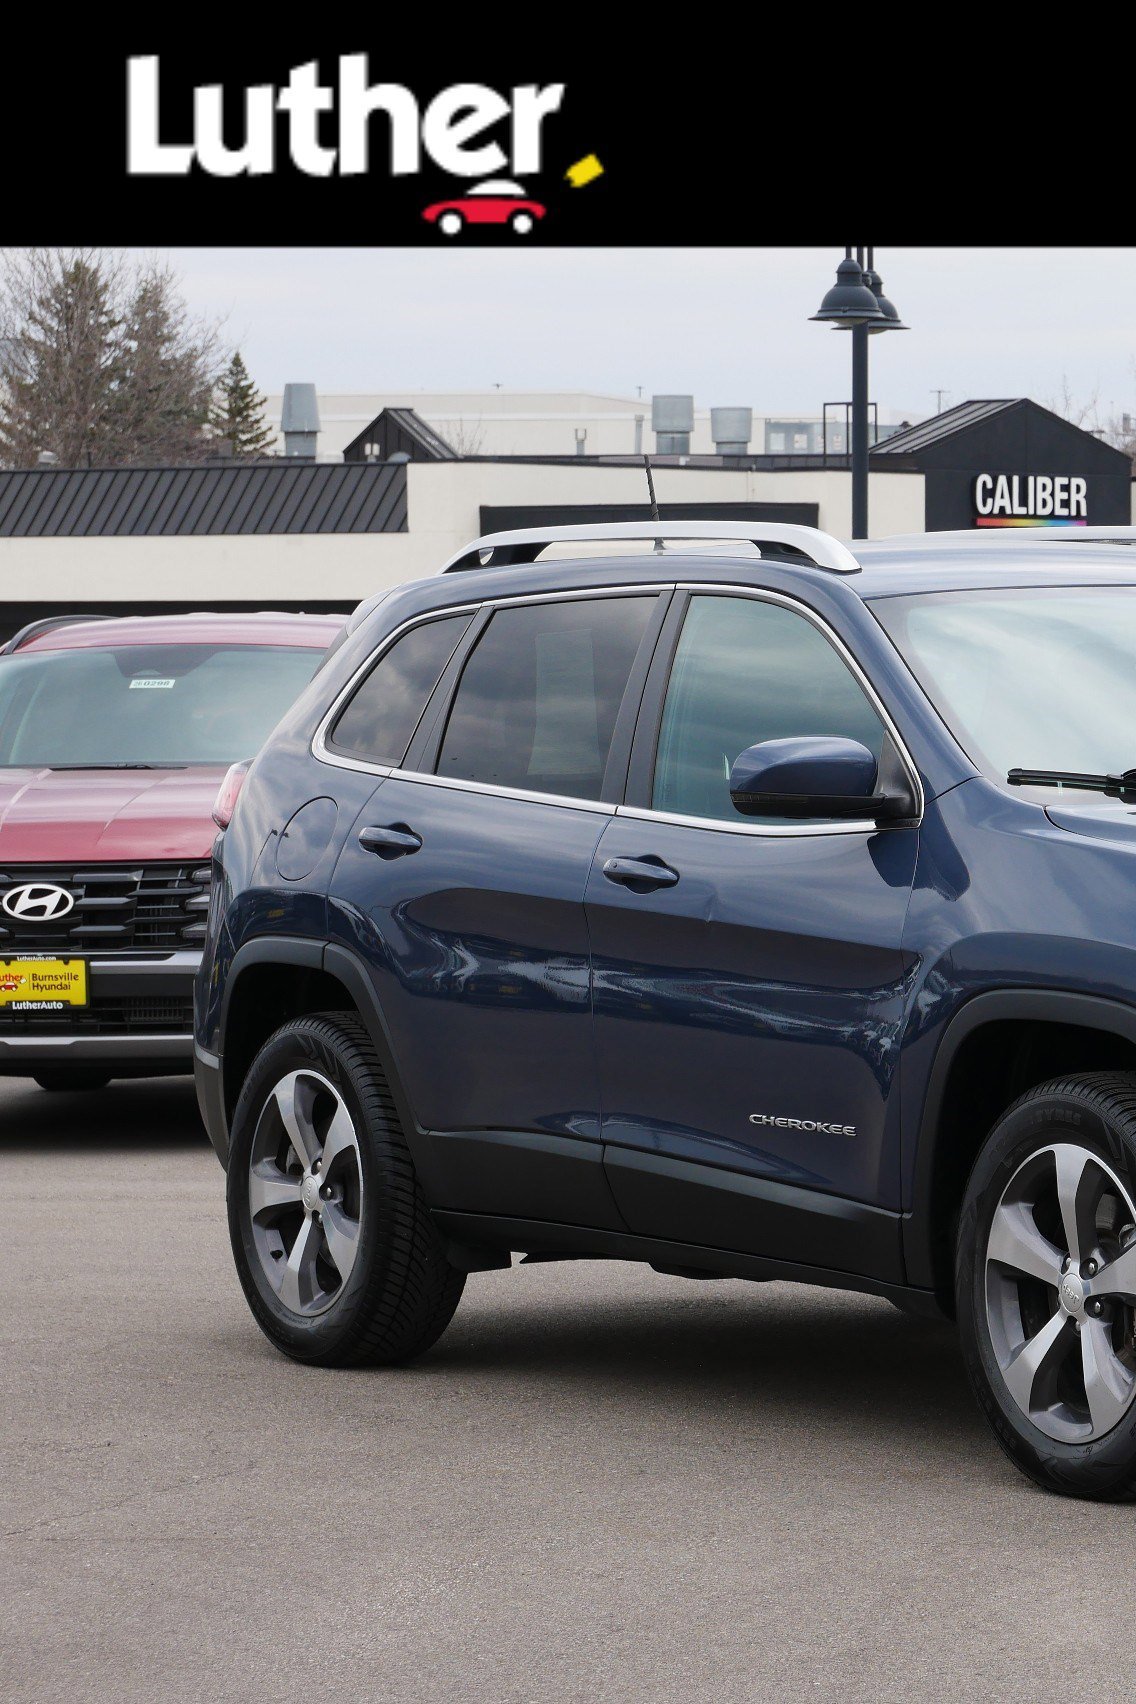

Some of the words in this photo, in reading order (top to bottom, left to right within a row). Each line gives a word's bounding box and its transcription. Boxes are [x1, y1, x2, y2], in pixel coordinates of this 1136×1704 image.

[975, 473, 1088, 517] CALIBER
[0, 972, 25, 982] uther
[31, 972, 80, 982] Burnsville
[32, 982, 72, 993] Hyundai
[11, 1000, 64, 1010] LutherAuto
[748, 1113, 857, 1137] CHEROKEE
